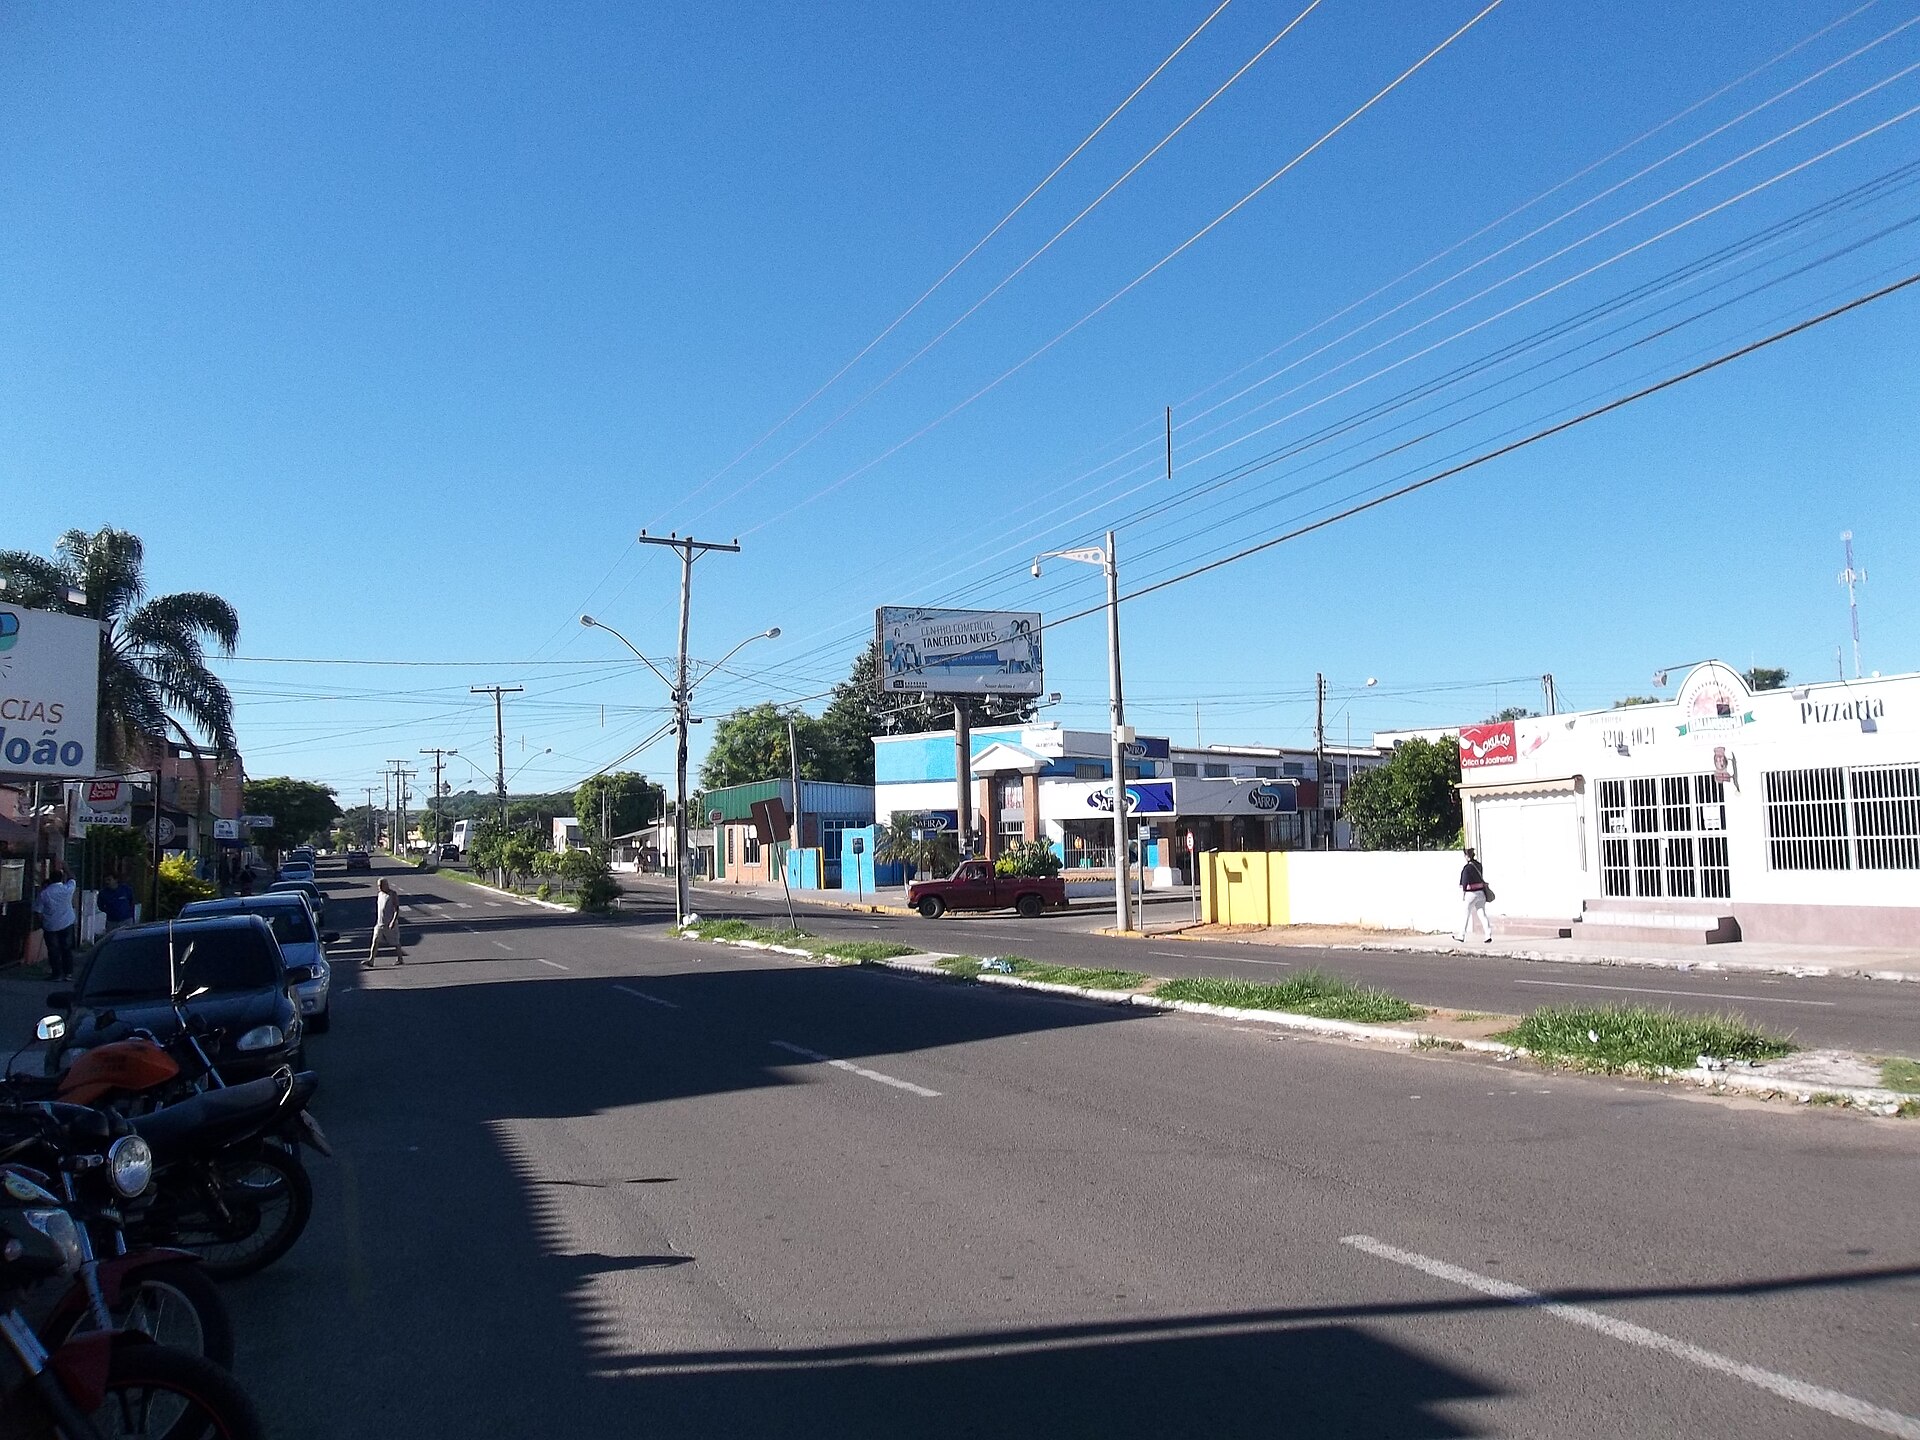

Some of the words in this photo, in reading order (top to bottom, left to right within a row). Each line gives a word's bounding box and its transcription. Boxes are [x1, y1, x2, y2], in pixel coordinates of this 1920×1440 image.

[921, 625, 951, 636] CENTRO
[953, 620, 995, 633] COMERCIAL
[922, 634, 968, 648] TANCREDO
[969, 631, 997, 644] NEVES
[1800, 695, 1885, 725] Pizzaria
[1481, 733, 1511, 752] OKULOS
[1485, 755, 1514, 766] Joalheria
[1252, 790, 1276, 808] SAFIRA
[79, 815, 94, 823] BAR
